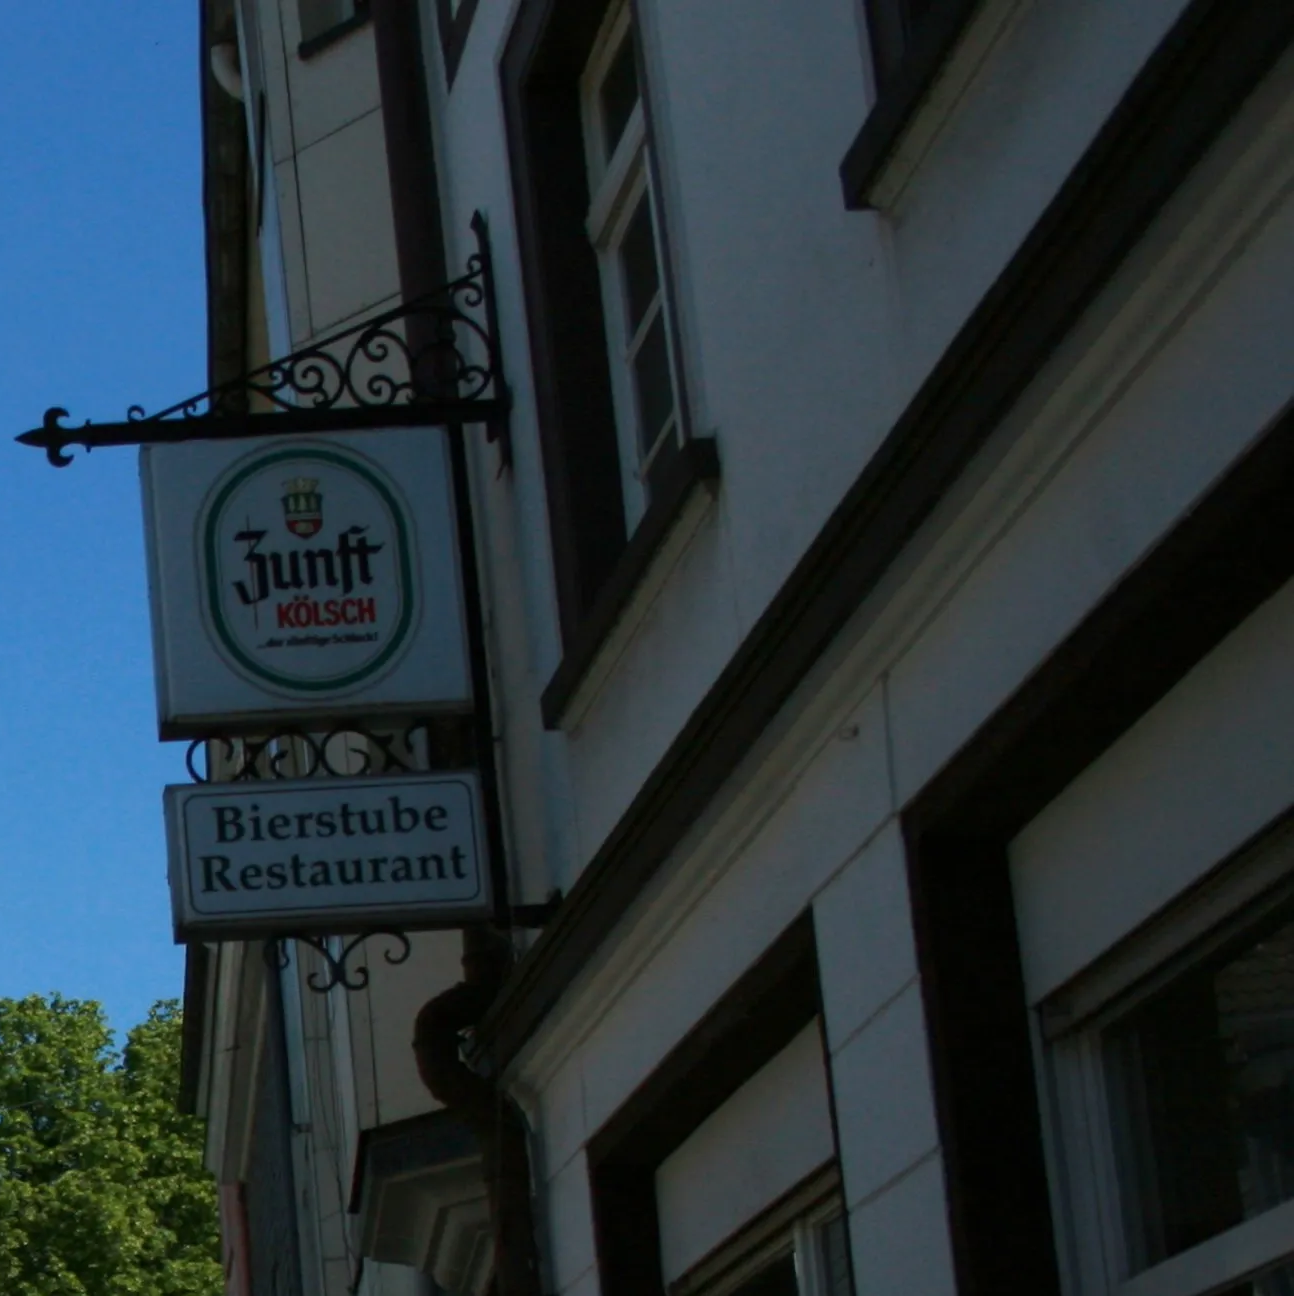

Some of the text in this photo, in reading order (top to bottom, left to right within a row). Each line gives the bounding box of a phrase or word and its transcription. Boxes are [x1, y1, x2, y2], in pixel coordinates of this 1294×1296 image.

[232, 525, 384, 605] Zunft
[277, 595, 376, 629] KÖLSCH
[215, 798, 447, 843] Bierstube
[200, 847, 467, 893] Restaurant
